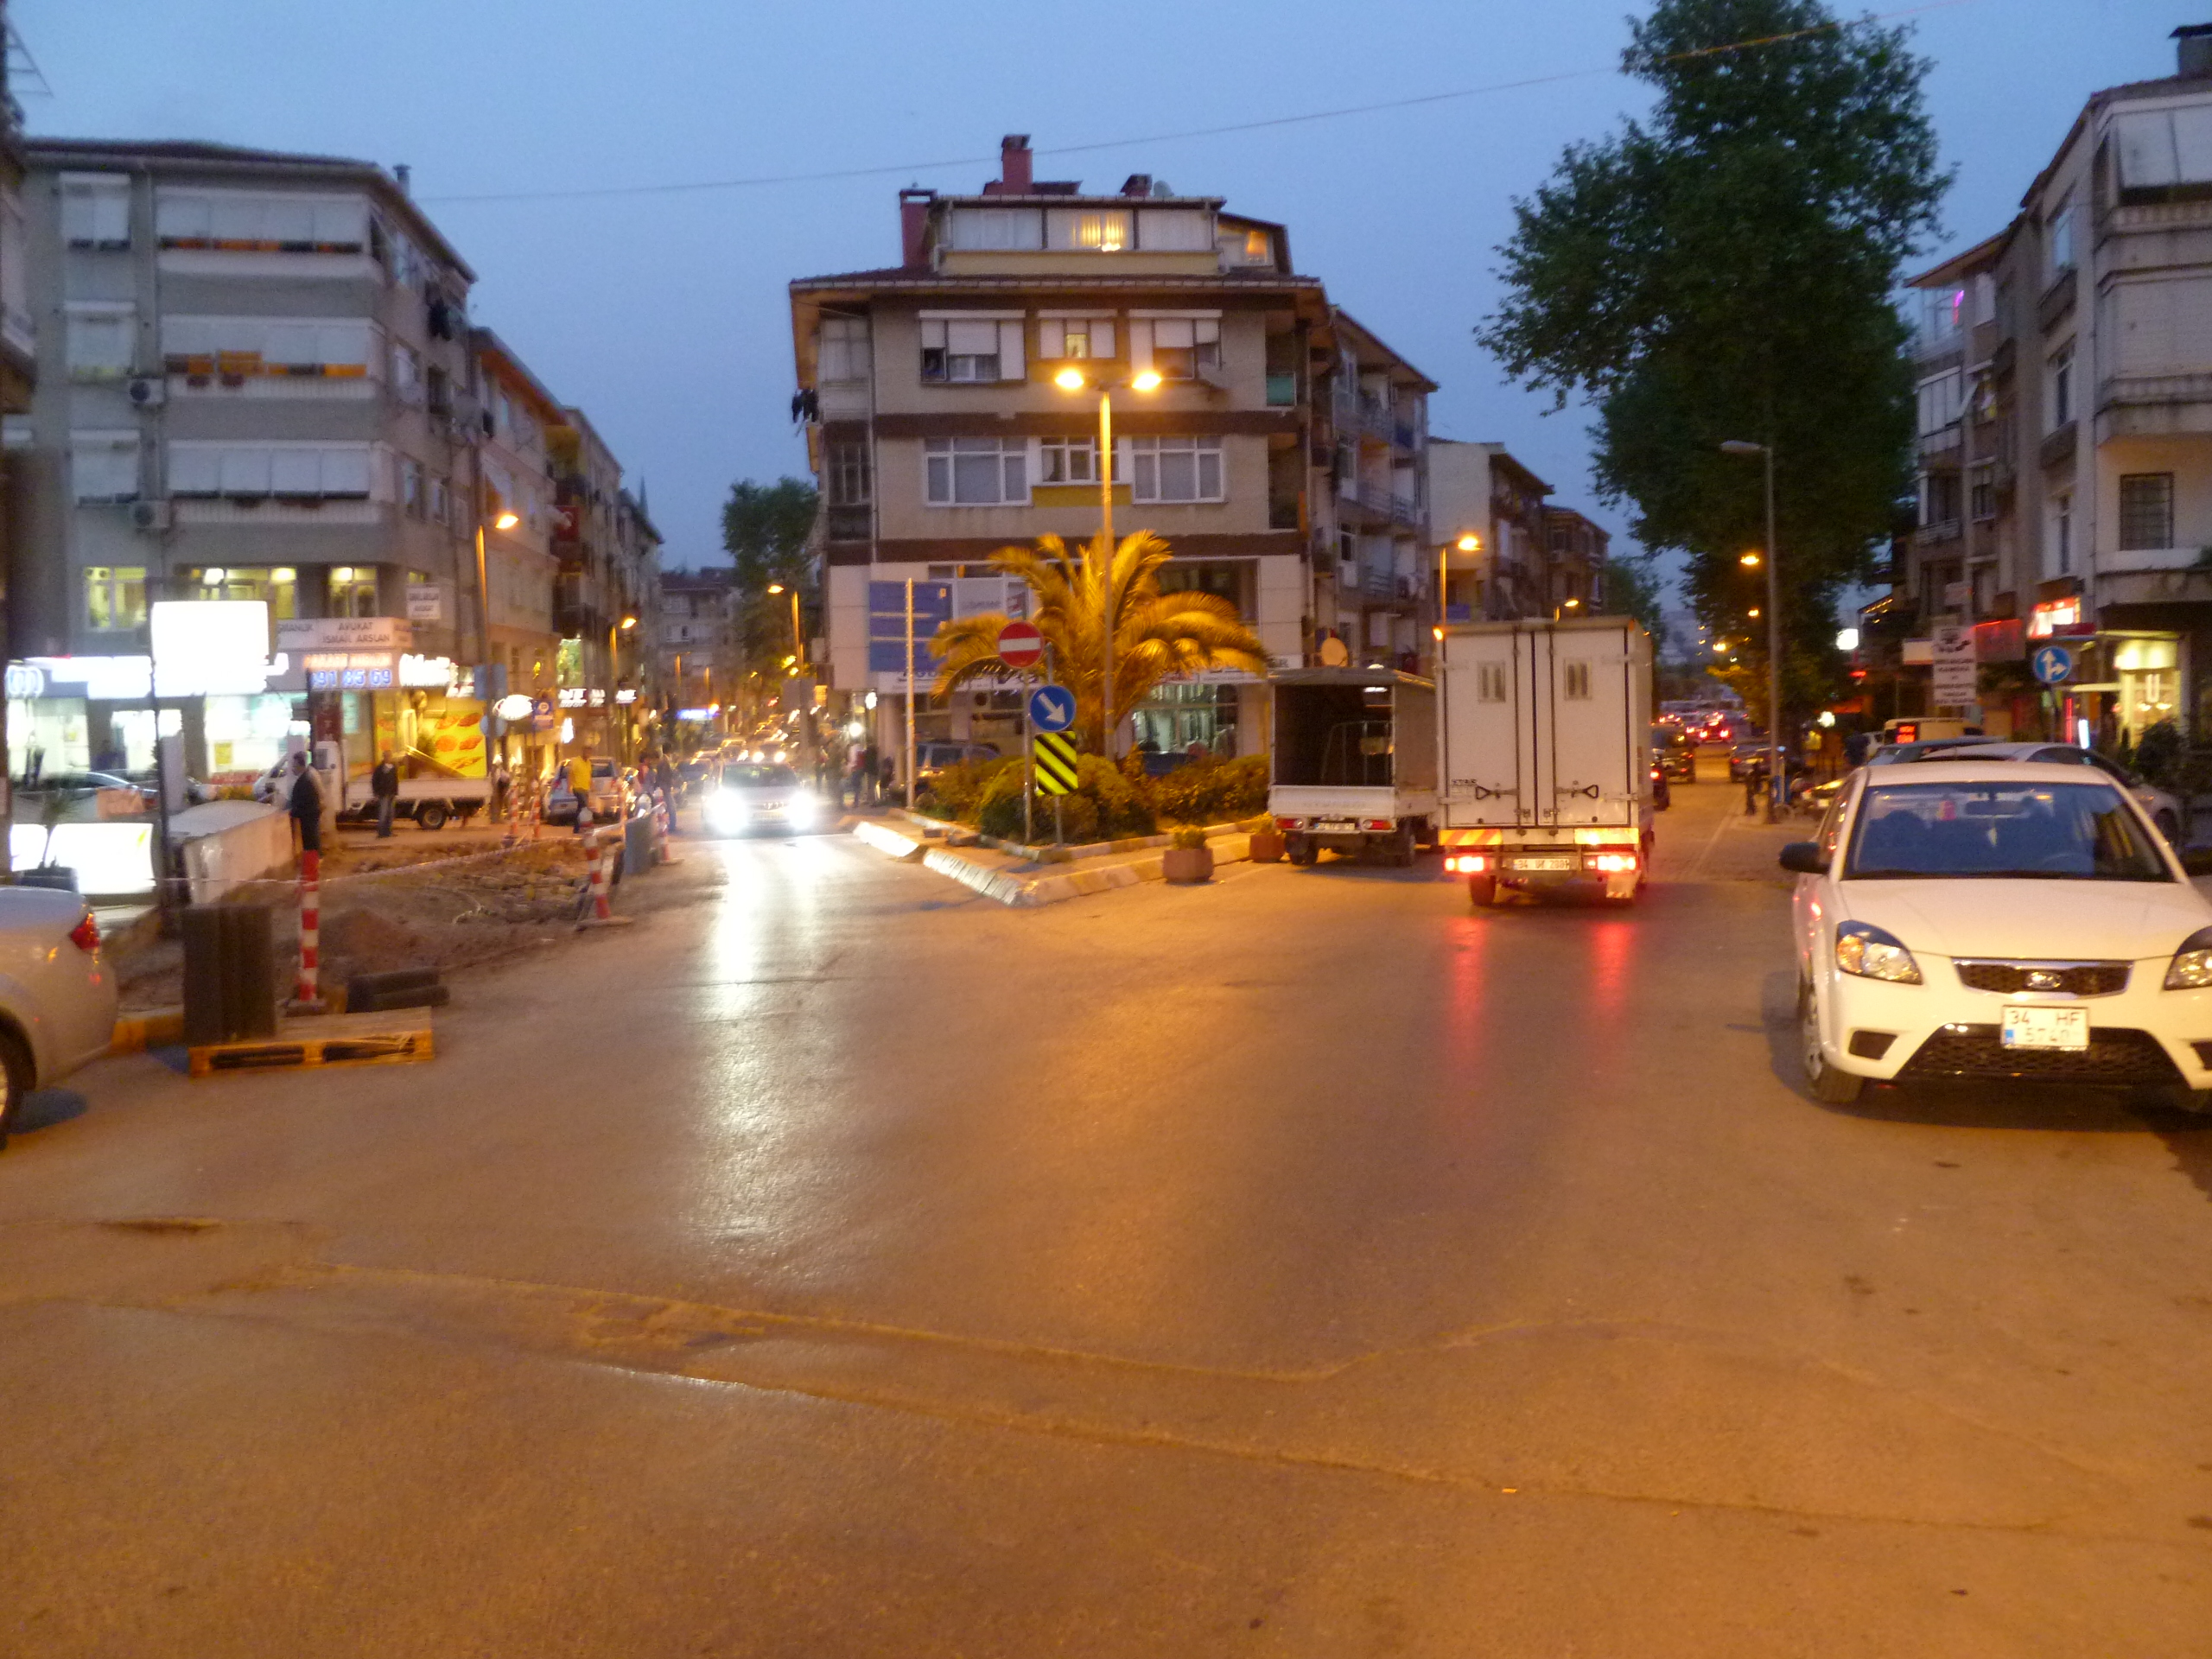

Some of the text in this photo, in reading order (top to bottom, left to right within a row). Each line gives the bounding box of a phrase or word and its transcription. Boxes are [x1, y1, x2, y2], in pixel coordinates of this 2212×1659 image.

[338, 621, 373, 632] AVUKAT
[356, 632, 391, 643] ARSLAN
[368, 668, 393, 685] 69
[2010, 1009, 2080, 1026] 34 HF
